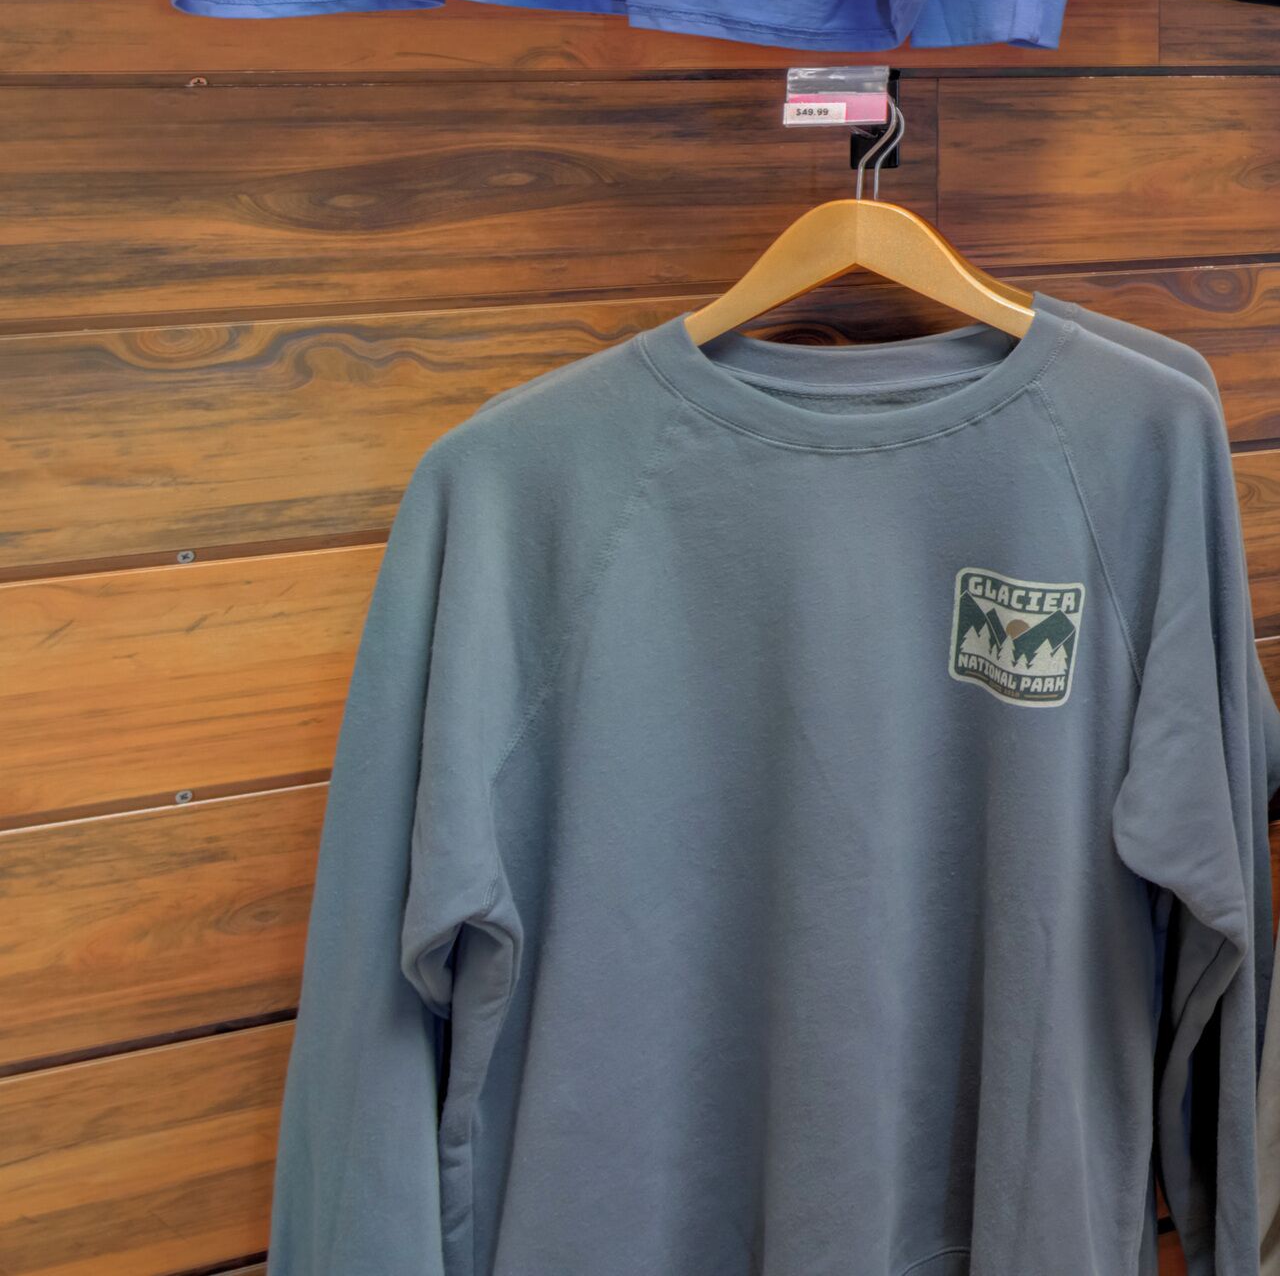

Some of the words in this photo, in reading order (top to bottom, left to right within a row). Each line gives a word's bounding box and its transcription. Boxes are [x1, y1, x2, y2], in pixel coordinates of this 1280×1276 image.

[796, 108, 829, 117] $49.99
[968, 577, 1076, 612] GLACIER
[958, 653, 1016, 690] NATIONAL
[1019, 675, 1067, 693] PARK
